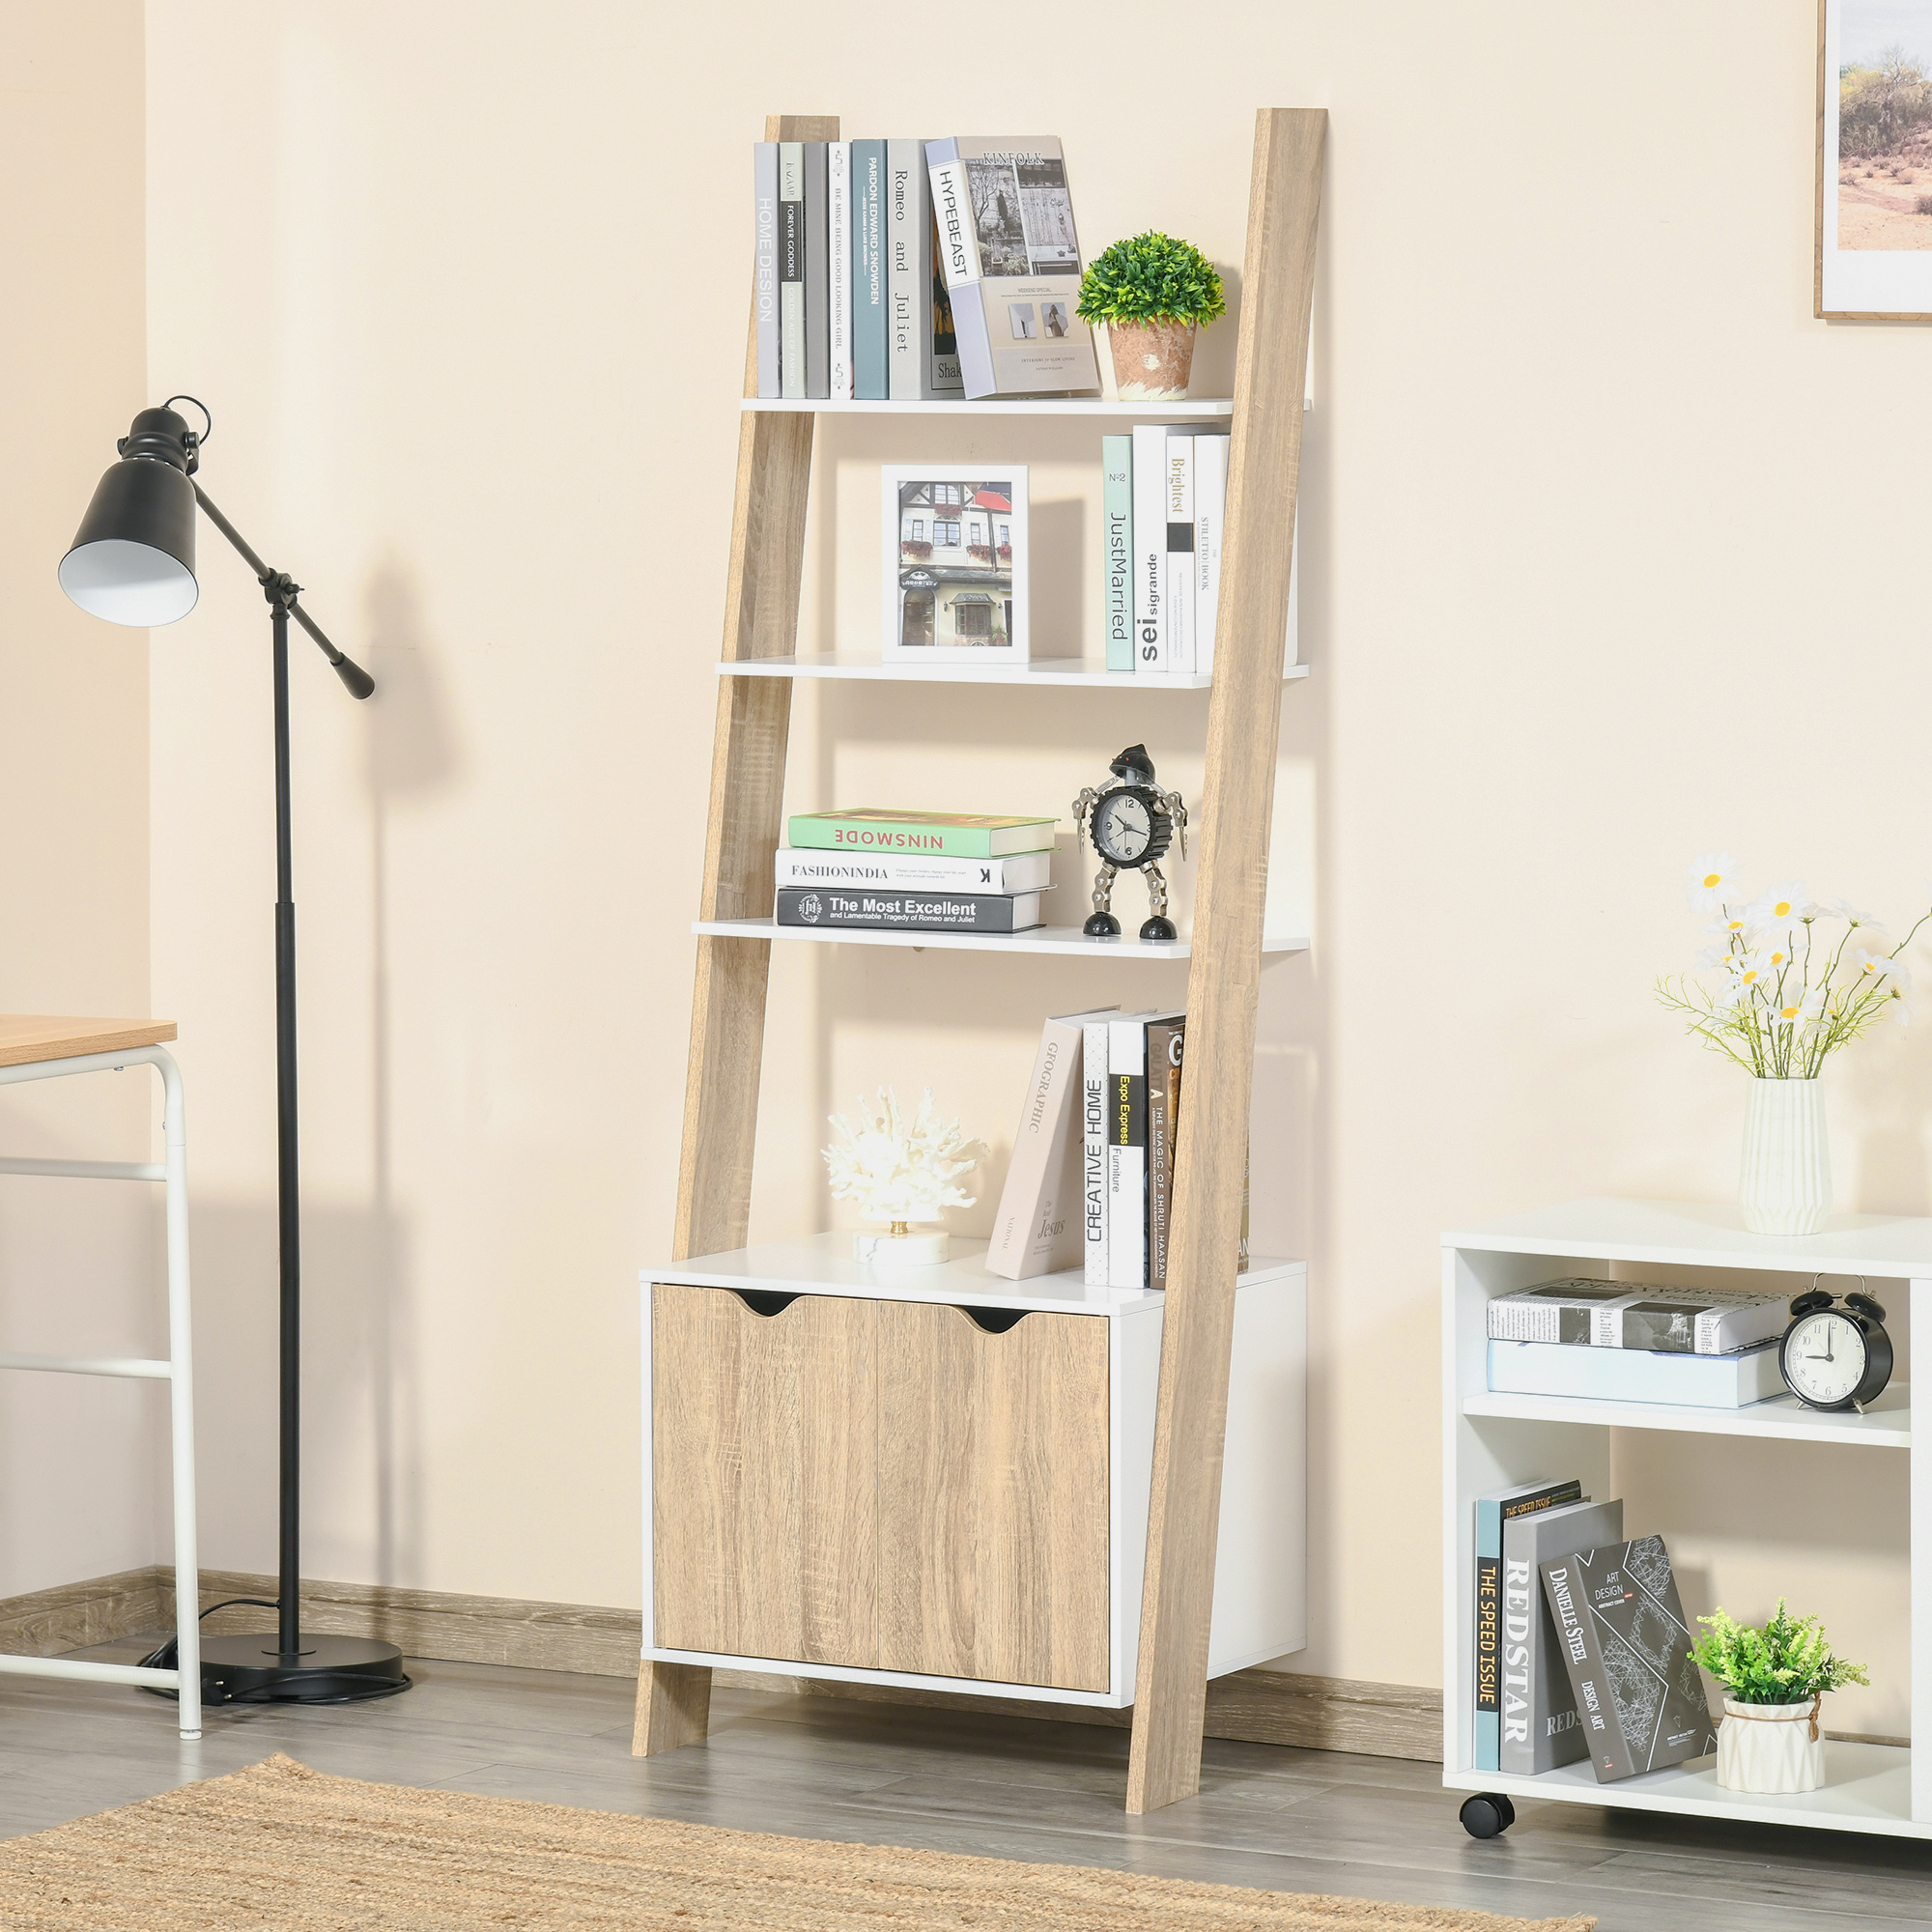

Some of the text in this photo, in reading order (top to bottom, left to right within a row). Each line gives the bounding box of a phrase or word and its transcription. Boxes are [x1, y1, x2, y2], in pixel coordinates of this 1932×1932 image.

[983, 152, 1044, 165] KINFOLK
[786, 162, 795, 196] BAZAAR
[835, 188, 842, 200] BE
[869, 157, 879, 305] PARDON EDWARD SNOWDEN
[939, 170, 967, 276] HYPEBEAST
[759, 197, 772, 322] HOME DESION
[895, 169, 909, 352] Romeo and Juliet
[1168, 458, 1185, 512] Brightest
[1111, 512, 1128, 640] JustMarried
[1137, 554, 1160, 661] sei sigrande
[1125, 799, 1134, 808] 12
[1106, 821, 1112, 830] 9
[835, 829, 943, 850] NINSMODE
[1126, 847, 1132, 855] 6
[791, 865, 888, 879] FASHIONINDIA
[829, 897, 976, 916] The Most Excellent
[883, 914, 909, 922] Tragedy
[1120, 1076, 1130, 1145] Expo Express
[1087, 1080, 1102, 1242] CREATIVE HOME
[1112, 1148, 1122, 1193] Furniture
[1157, 1174, 1164, 1189] OF
[1002, 1217, 1015, 1250] NATIONAL
[1037, 1219, 1065, 1239] Jesus
[1814, 1324, 1849, 1335] 11 1
[1803, 1335, 1861, 1347] 10 2
[1796, 1351, 1865, 1365] 9 3
[1800, 1368, 1858, 1381] 8 4
[1812, 1380, 1848, 1393] 7 5
[1825, 1386, 1832, 1396] 6
[1607, 1571, 1619, 1584] ART
[1594, 1584, 1623, 1600] DESIGN
[1549, 1566, 1588, 1665] DANIELLE STEEL
[1479, 1566, 1496, 1705] THE SPEED ISSUE
[1504, 1557, 1530, 1744] REDSTAR
[1581, 1680, 1605, 1730] DESIGN ART
